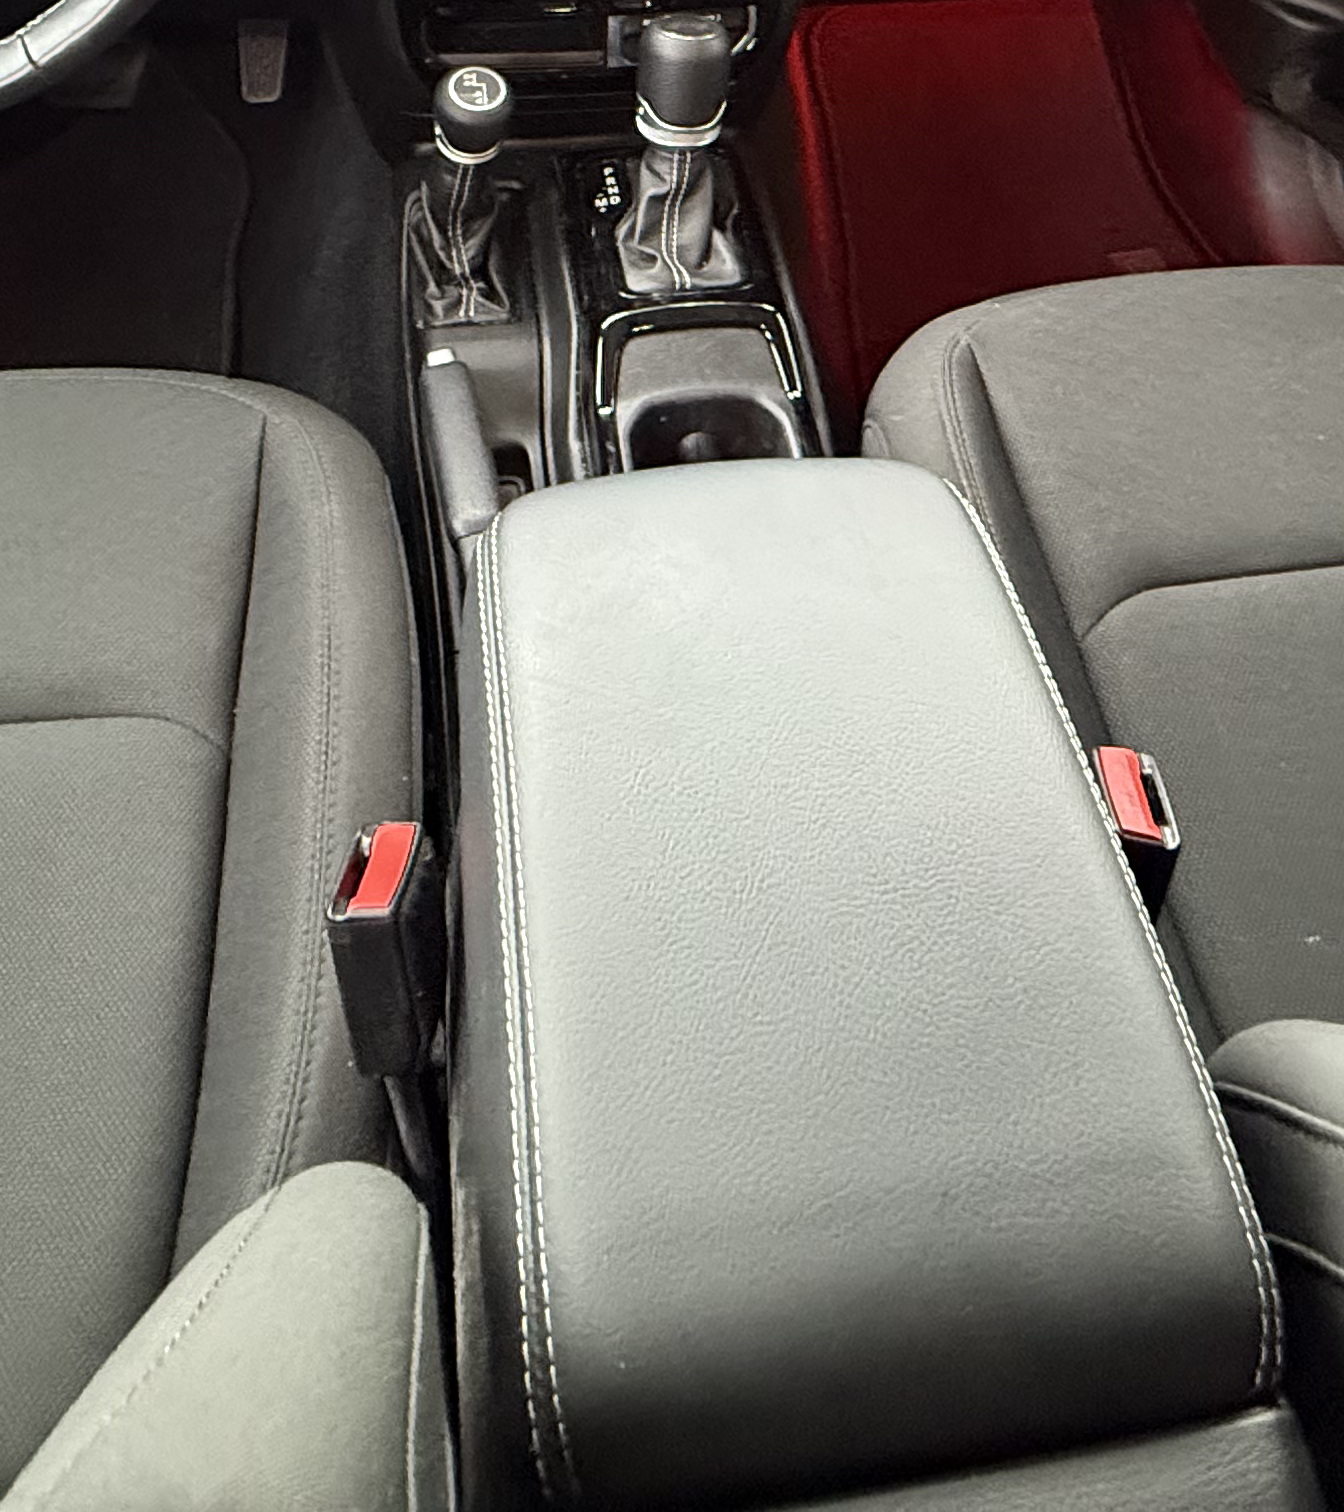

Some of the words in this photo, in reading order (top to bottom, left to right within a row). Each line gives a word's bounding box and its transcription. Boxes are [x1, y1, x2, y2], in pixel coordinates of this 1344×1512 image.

[603, 166, 614, 177] P
[607, 185, 620, 195] N
[594, 196, 609, 208] M
[609, 195, 622, 205] D
